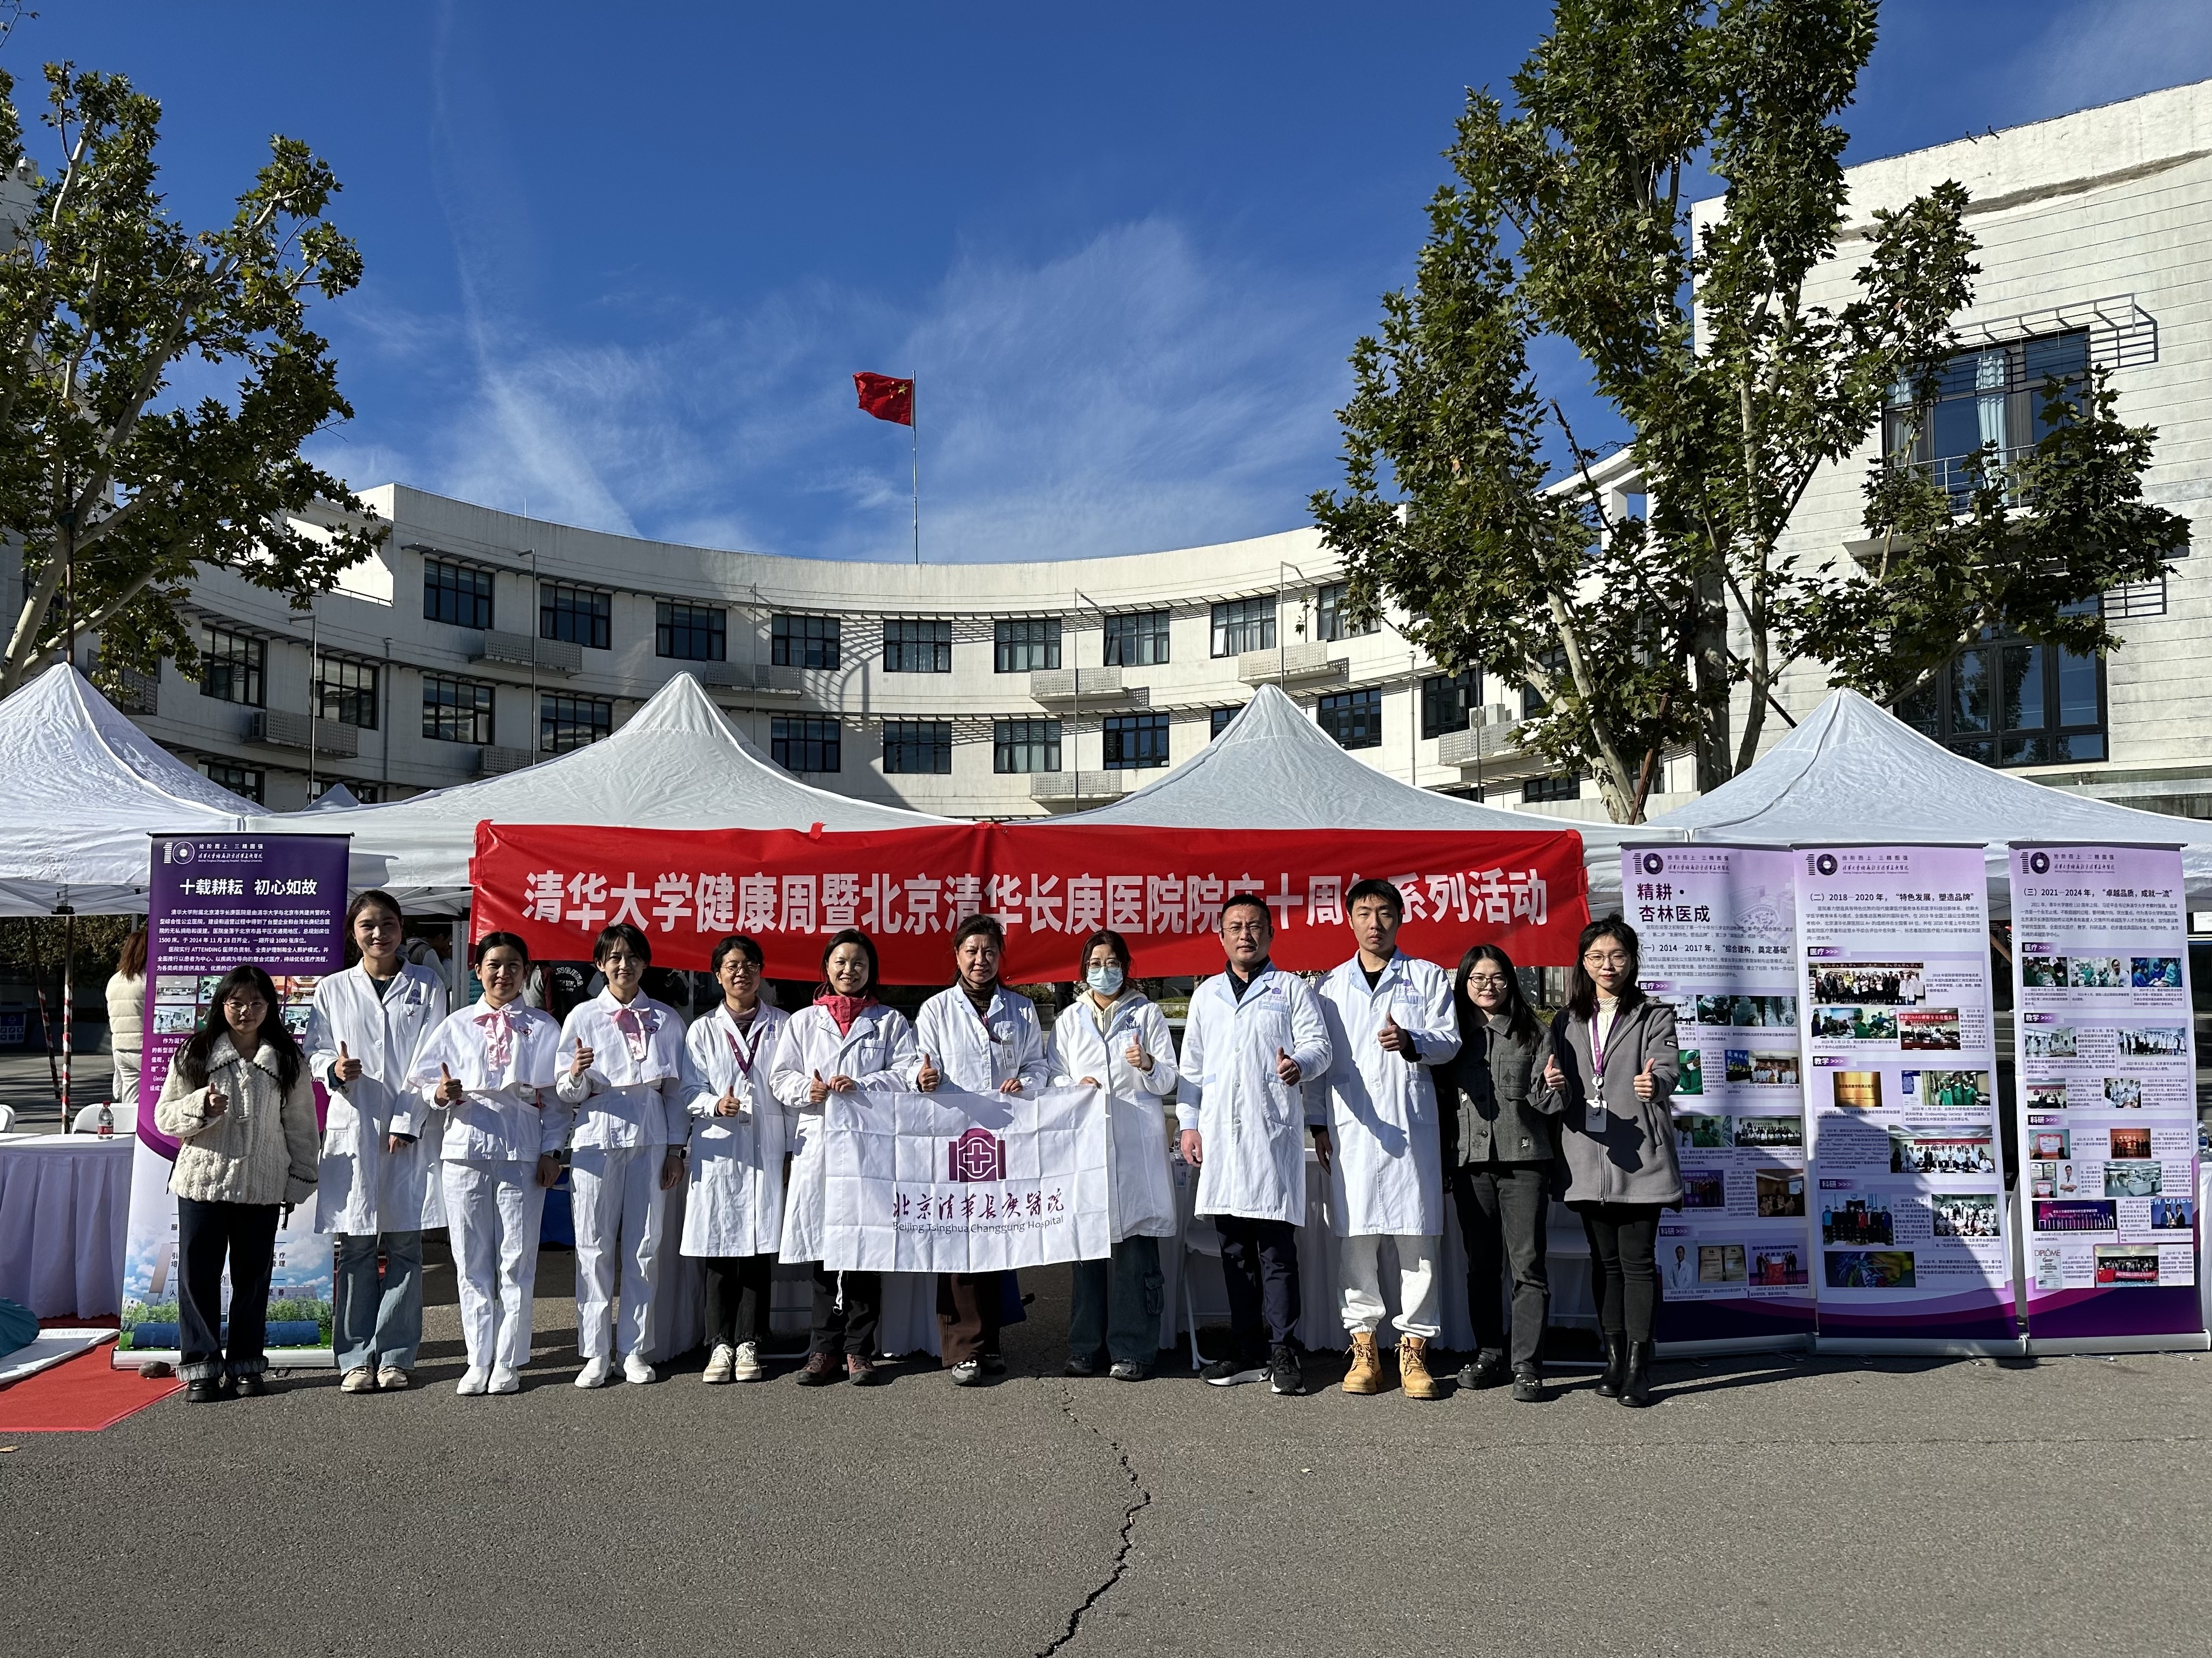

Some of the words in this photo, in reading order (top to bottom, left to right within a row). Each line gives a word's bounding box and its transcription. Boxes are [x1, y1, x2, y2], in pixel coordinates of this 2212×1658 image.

[180, 879, 243, 895] 十载耕耘
[254, 879, 317, 895] 初心如故
[522, 868, 1547, 935] 清华大学健康周暨北京清华长庚医院院十周系列活动
[1639, 905, 1710, 922] 杏林医成
[1822, 1180, 1836, 1189] 科研
[893, 1221, 924, 1234] Beijing
[927, 1222, 968, 1235] Tsinghua
[971, 1222, 1025, 1235] Changgung
[1028, 1214, 1064, 1230] Hospital
